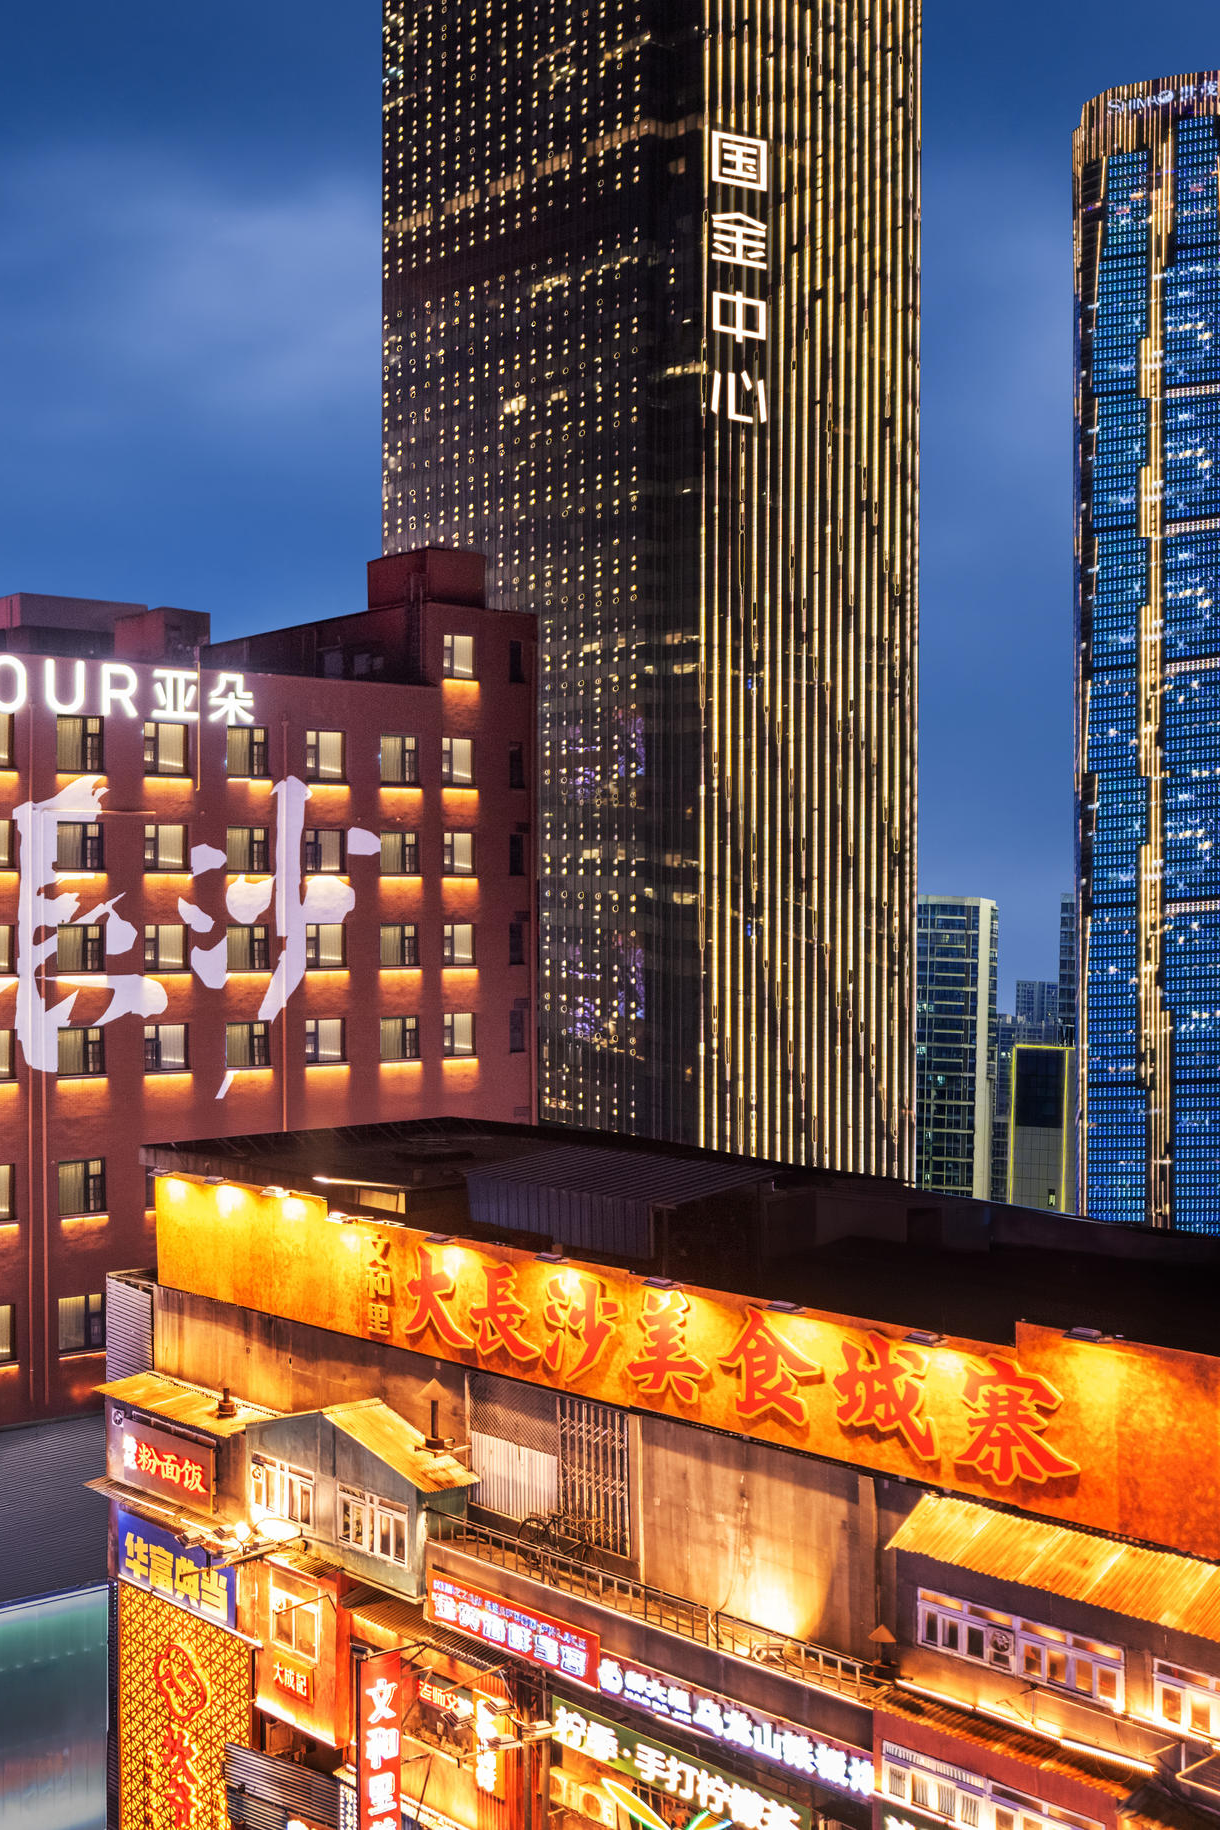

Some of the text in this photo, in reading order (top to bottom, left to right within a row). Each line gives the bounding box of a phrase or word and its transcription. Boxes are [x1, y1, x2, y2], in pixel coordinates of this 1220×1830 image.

[711, 130, 768, 424] 国金中心
[151, 667, 256, 727] 亚朵
[363, 1232, 392, 1336] 文和里
[137, 1442, 208, 1494] 粉面饭
[124, 1531, 229, 1622] 华富典当
